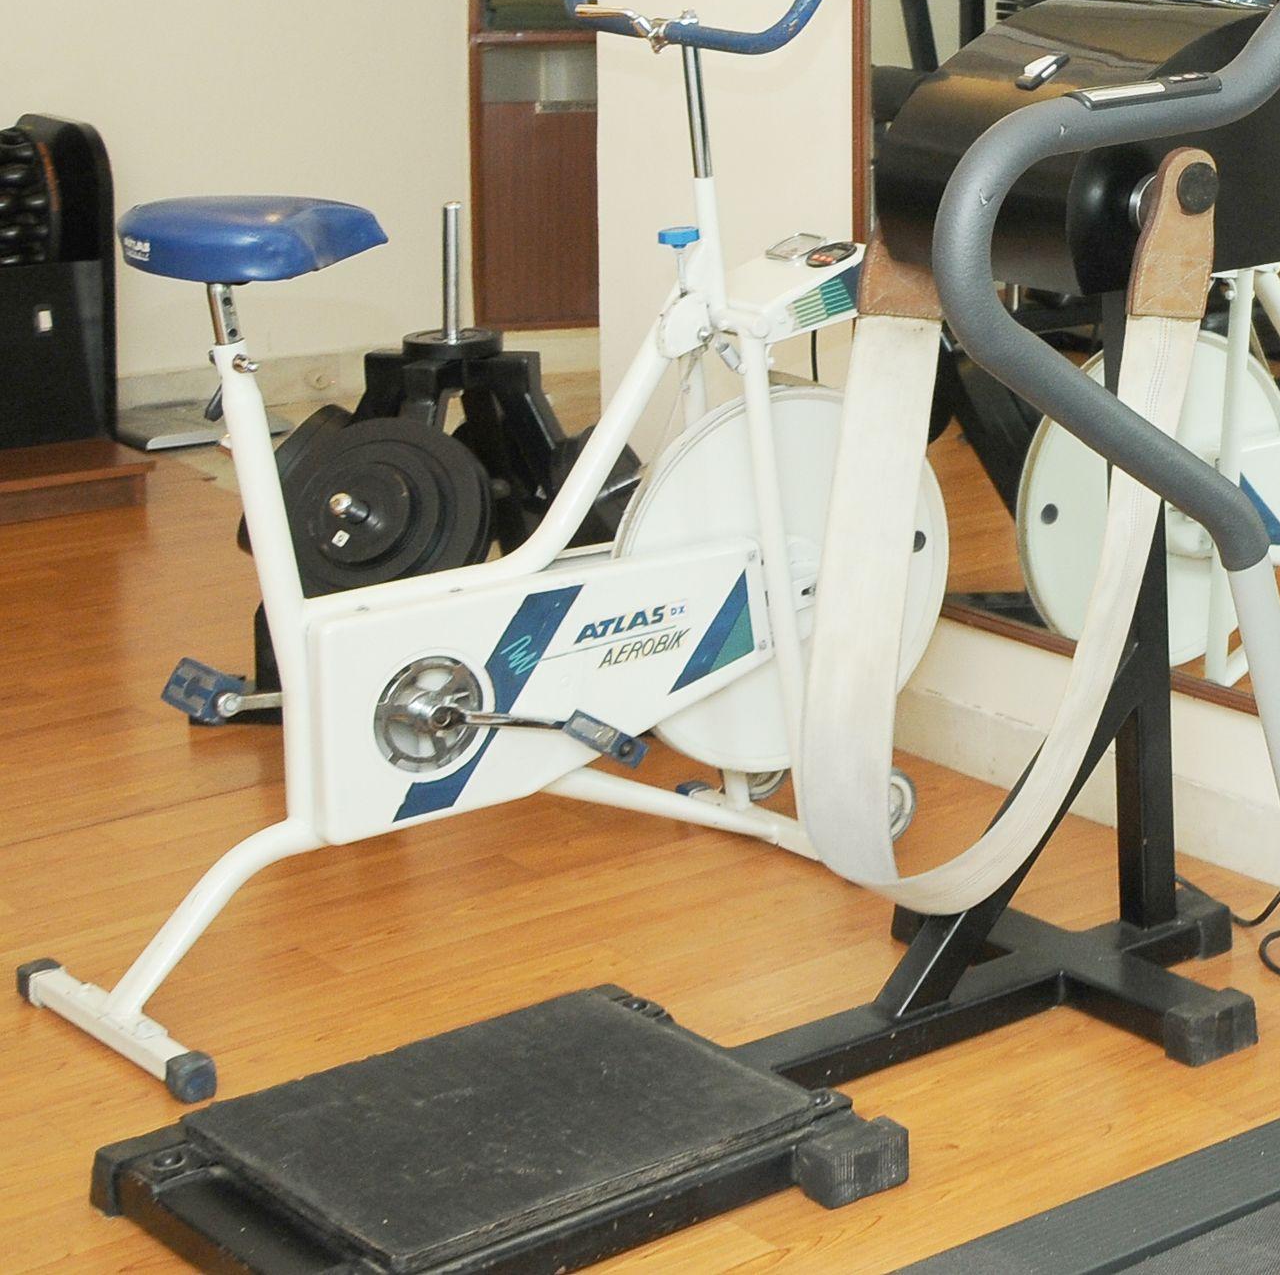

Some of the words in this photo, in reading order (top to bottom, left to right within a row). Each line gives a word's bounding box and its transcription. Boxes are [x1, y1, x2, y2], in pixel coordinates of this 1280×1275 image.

[572, 604, 667, 645] ATLAS
[670, 605, 686, 617] DX
[598, 627, 692, 670] AEROBIK
